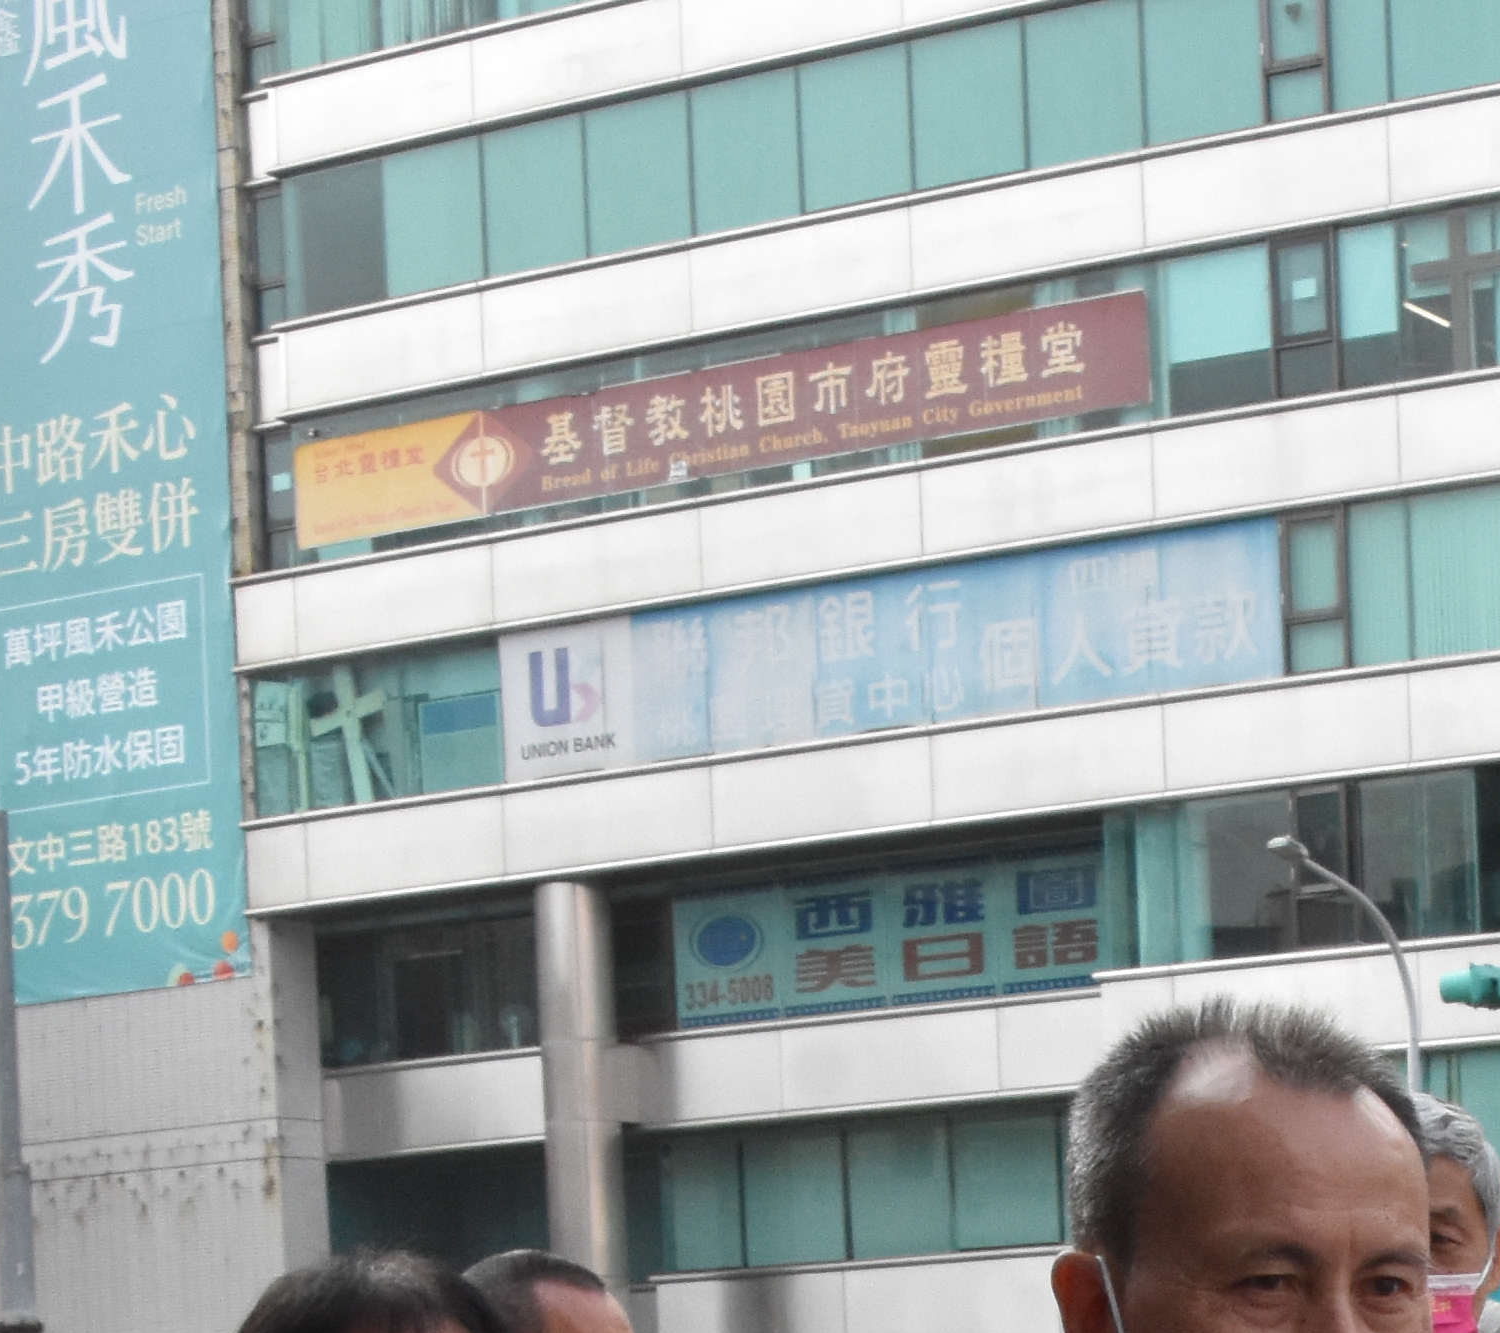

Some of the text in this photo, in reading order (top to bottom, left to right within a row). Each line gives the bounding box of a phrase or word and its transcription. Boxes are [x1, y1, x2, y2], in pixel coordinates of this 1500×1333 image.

[135, 184, 188, 214] Fresh
[136, 218, 182, 247] Start
[540, 320, 1088, 465] 基督教桃園市府靈糧堂
[541, 470, 592, 492] Bread
[600, 465, 618, 483] of
[625, 458, 660, 479] Life
[838, 414, 912, 442] Taoyuan
[922, 404, 961, 427] City
[969, 384, 1084, 417] Government
[3, 599, 188, 672] 萬坪風禾公園
[36, 666, 159, 720] 甲級營造
[14, 724, 186, 787] 5年防水保固
[520, 731, 617, 761] UNION BANK
[8, 810, 213, 879] 文中三路183號
[104, 866, 215, 935] 7000
[793, 862, 1098, 942] 西雅圖
[794, 919, 1100, 994] 美日語
